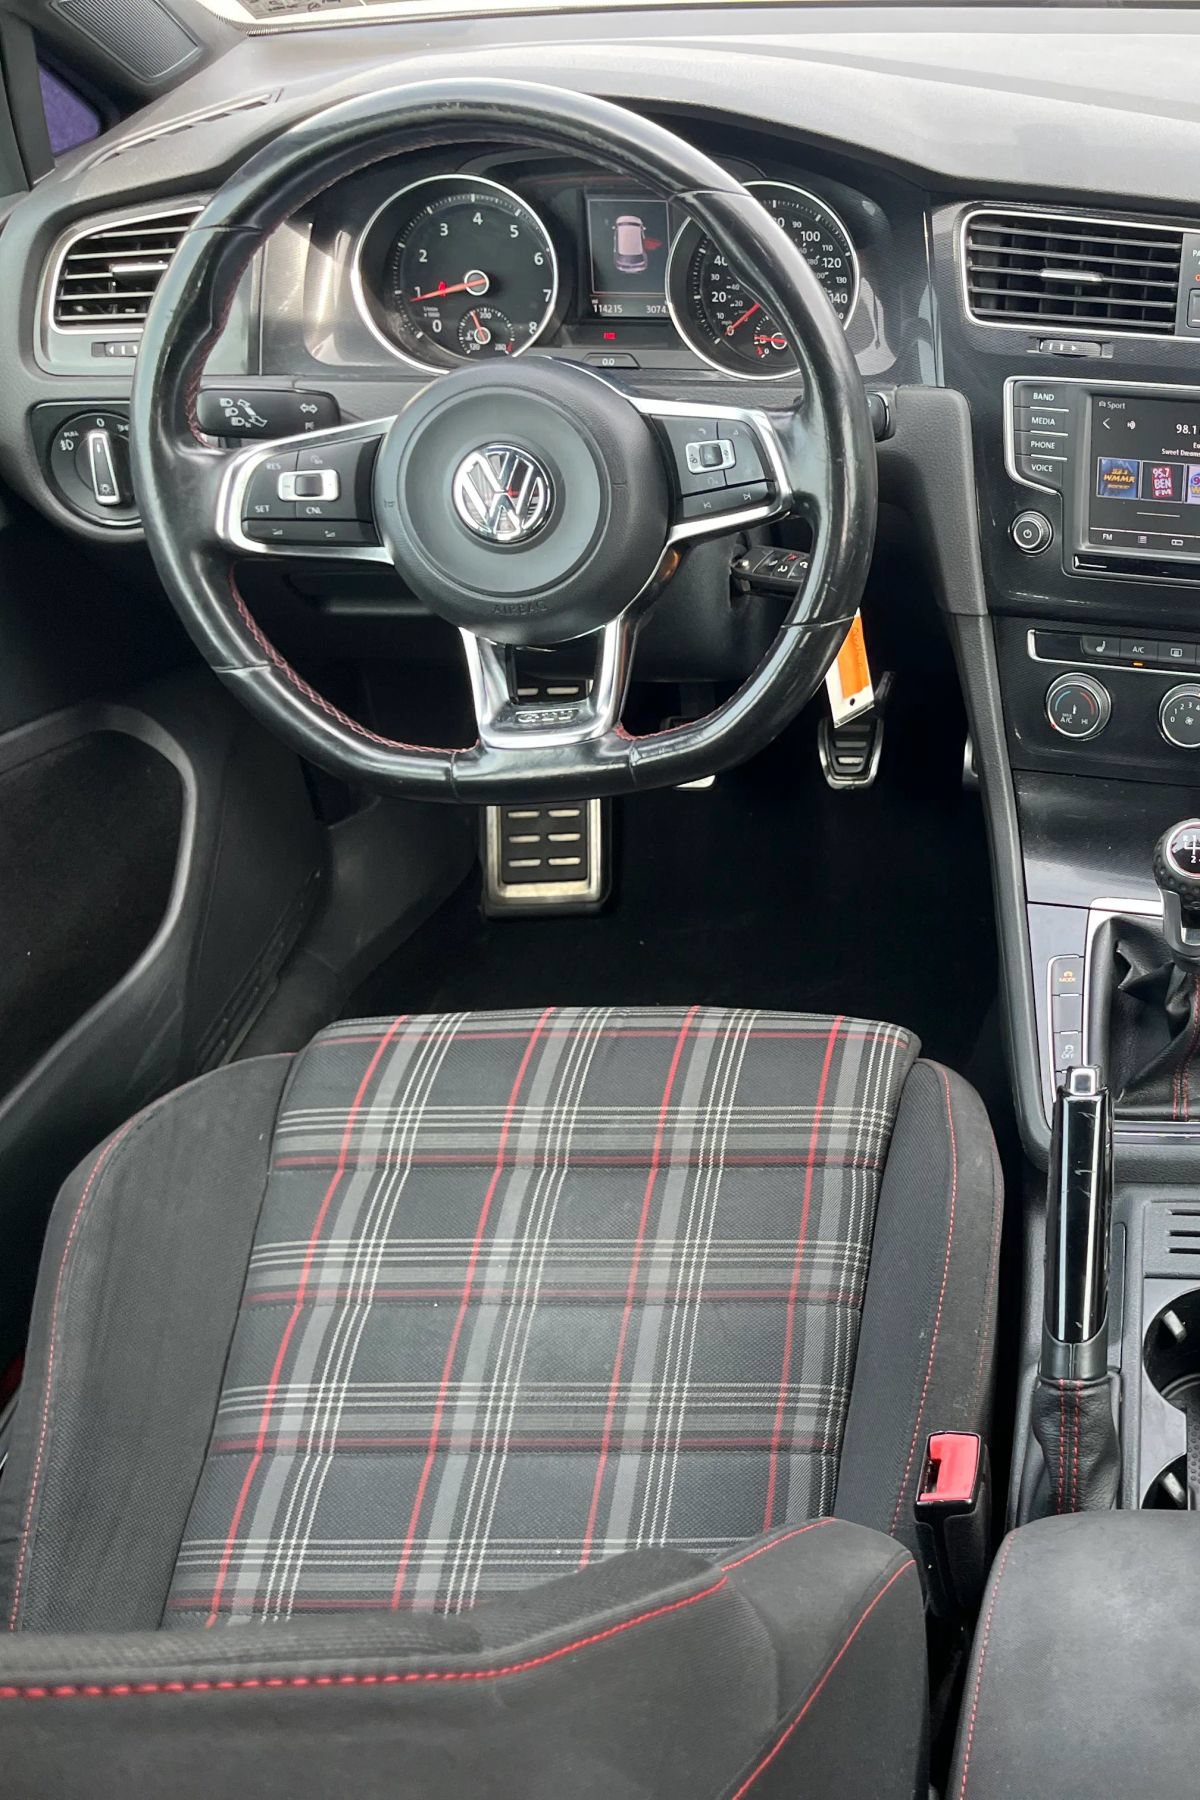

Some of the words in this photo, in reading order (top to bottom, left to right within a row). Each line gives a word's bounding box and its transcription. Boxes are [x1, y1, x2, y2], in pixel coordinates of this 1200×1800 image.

[472, 212, 484, 226] 4
[440, 224, 449, 237] 3
[510, 225, 519, 238] 5
[801, 231, 821, 242] 100
[822, 244, 833, 252] 110
[418, 250, 428, 263] 2
[534, 252, 544, 265] 6
[823, 258, 842, 268] 120
[710, 273, 720, 281] 30
[414, 286, 421, 298] 1
[543, 289, 552, 302] 7
[711, 291, 727, 303] 20
[829, 293, 848, 304] 140
[592, 304, 623, 313] 114215
[432, 319, 442, 333] 0
[529, 321, 538, 335] 8
[1032, 391, 1055, 402] BAND
[1106, 401, 1126, 410] Sport
[1031, 416, 1056, 426] MEDIA
[1175, 424, 1197, 435] 98.1
[1030, 440, 1055, 450] PHONE
[1031, 463, 1053, 473] VOICE
[1153, 478, 1172, 489] BEN
[254, 504, 270, 513] SET
[306, 506, 322, 514] CNL
[1102, 533, 1113, 541] FM
[1132, 645, 1145, 655] A/C
[1190, 855, 1197, 863] 2
